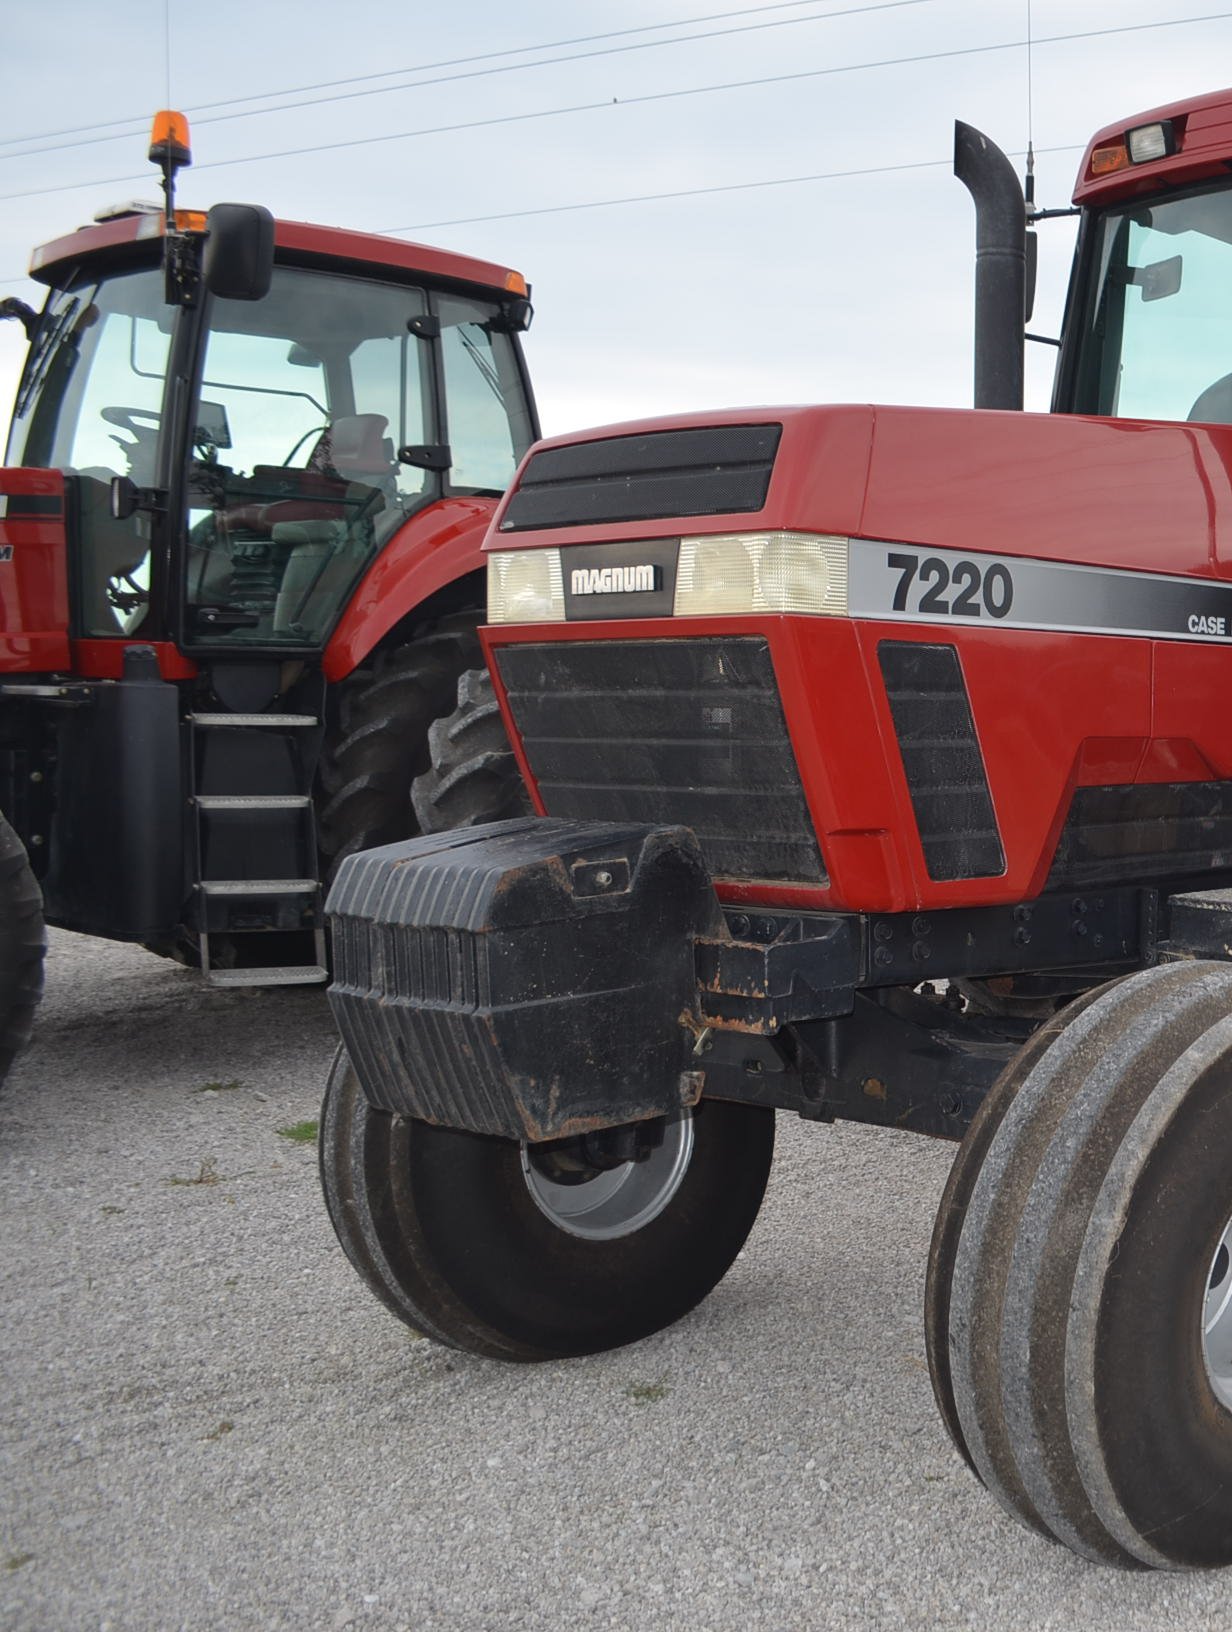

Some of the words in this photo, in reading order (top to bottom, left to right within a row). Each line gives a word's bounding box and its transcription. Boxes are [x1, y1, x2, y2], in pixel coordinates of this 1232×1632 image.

[571, 564, 655, 595] MAGNUM
[888, 552, 1014, 619] 7220
[1188, 614, 1226, 635] CASE
